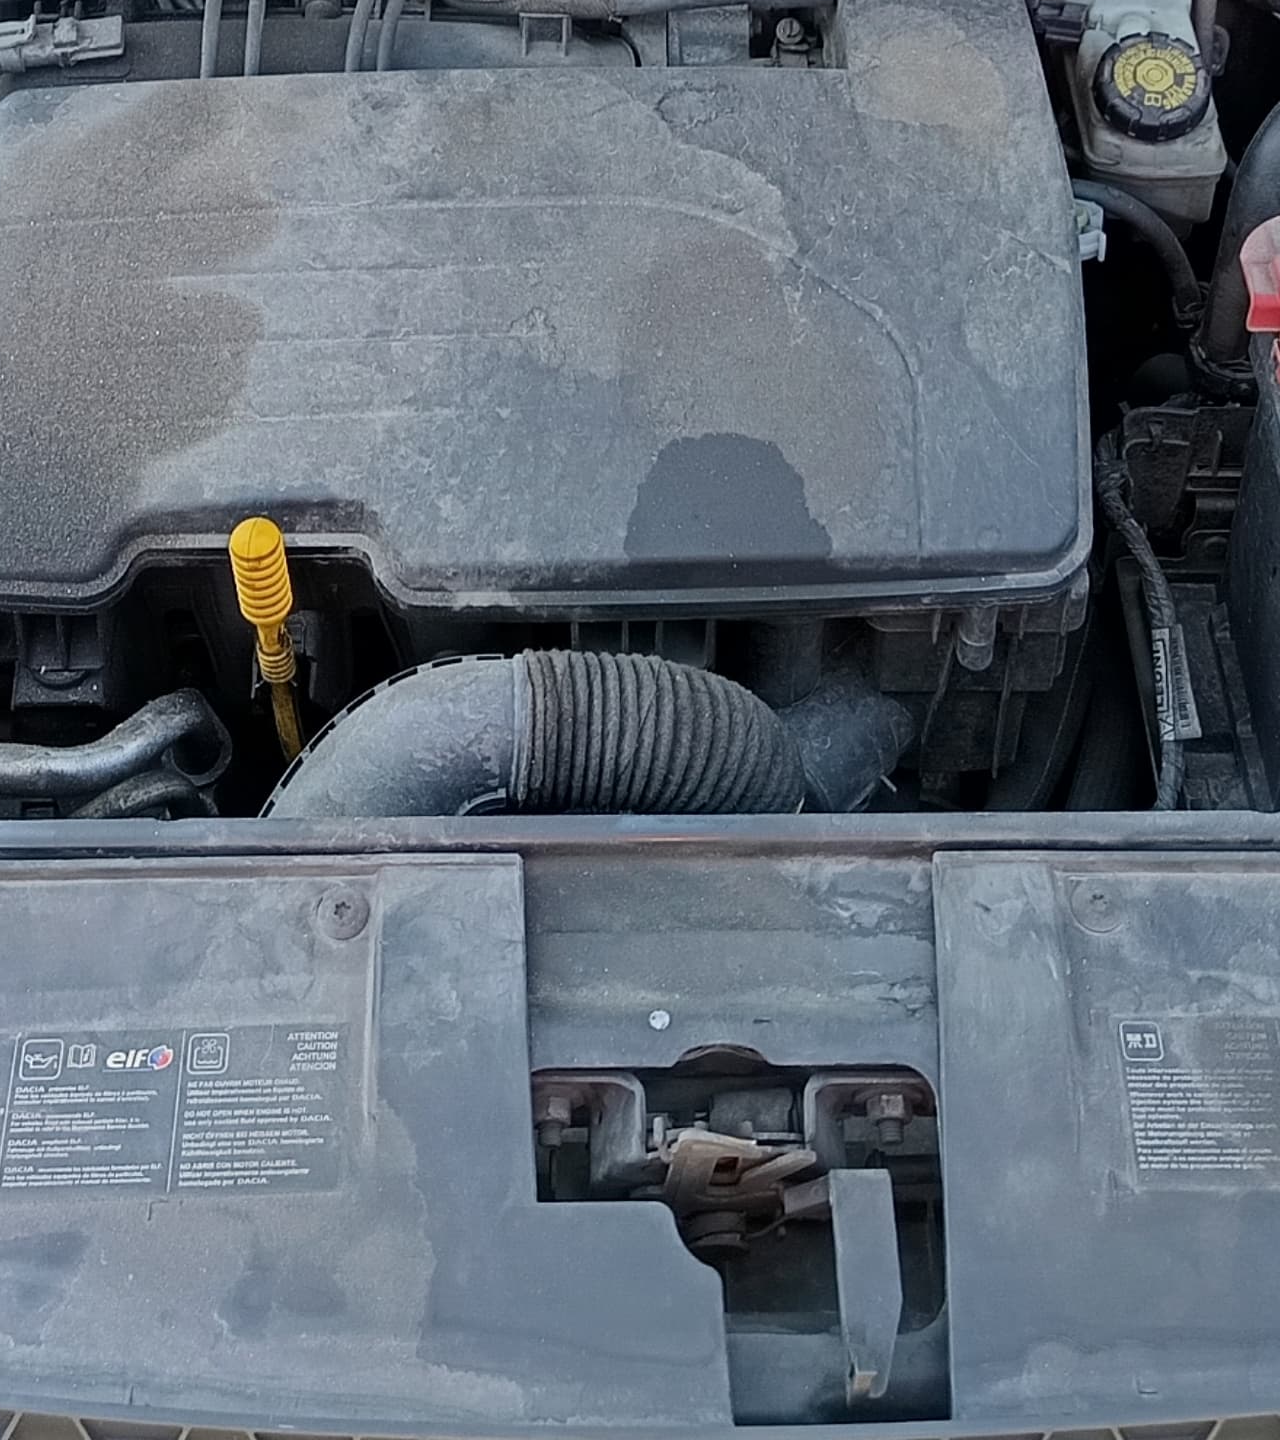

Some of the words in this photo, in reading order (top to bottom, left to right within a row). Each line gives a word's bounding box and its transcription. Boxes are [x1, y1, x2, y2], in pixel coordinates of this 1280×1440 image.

[287, 1032, 338, 1041] ATTENTION
[297, 1042, 337, 1050] CAUTION
[106, 1049, 149, 1069] elf
[291, 1052, 337, 1061] ACHTUNG
